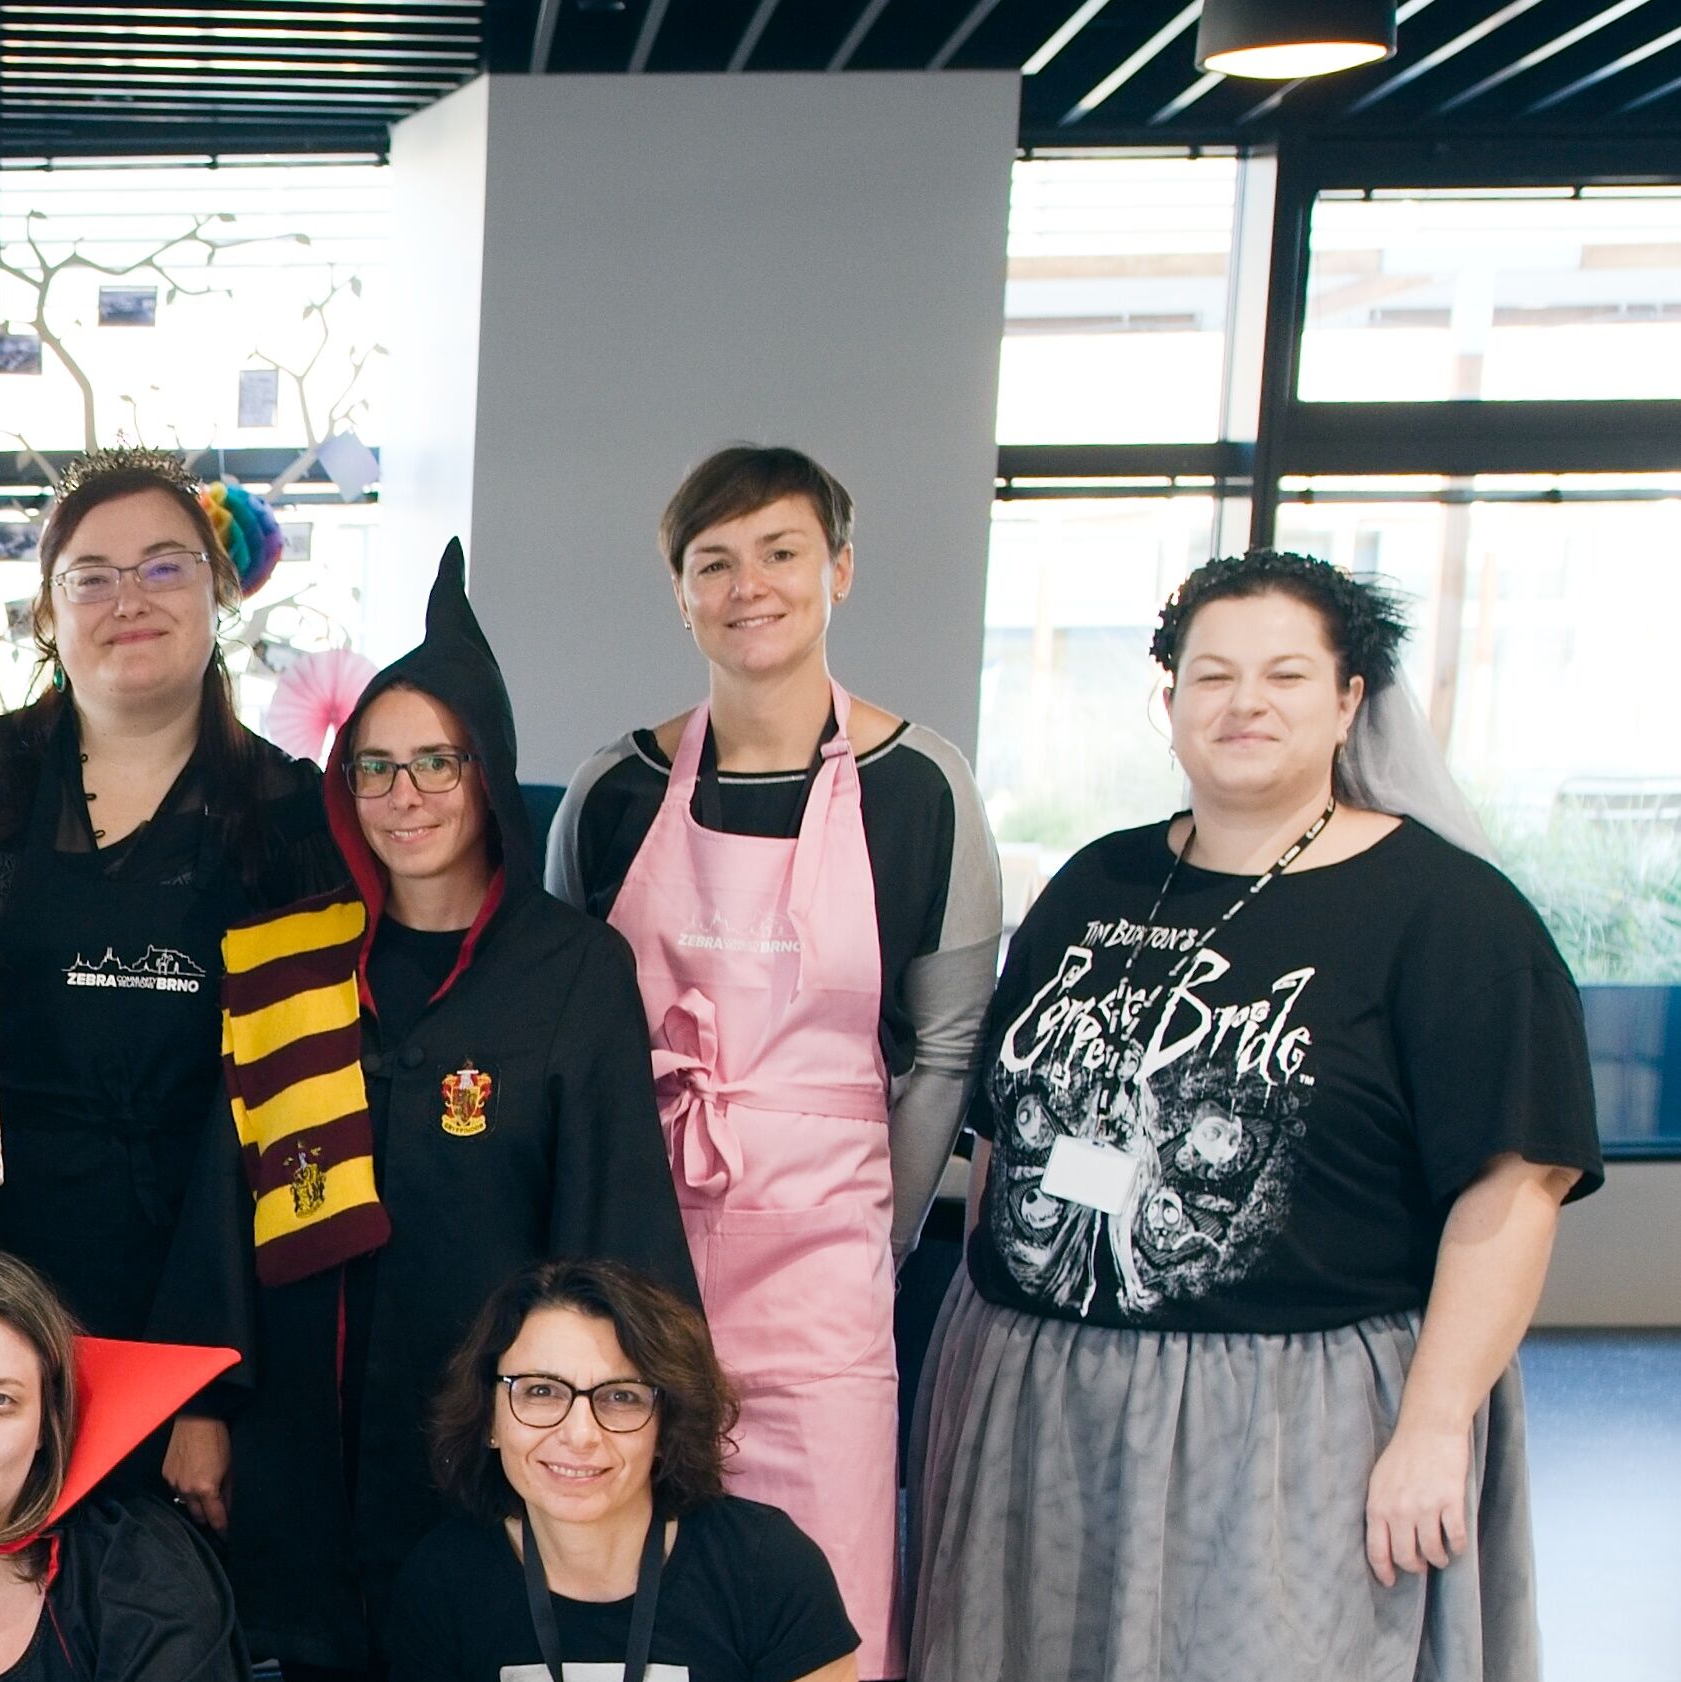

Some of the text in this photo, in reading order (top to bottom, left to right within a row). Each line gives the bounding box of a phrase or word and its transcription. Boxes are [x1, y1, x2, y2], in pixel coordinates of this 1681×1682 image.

[678, 933, 723, 950] ZEBRA
[1080, 920, 1114, 947] TIM
[67, 972, 199, 993] ZEBRA BRNO
